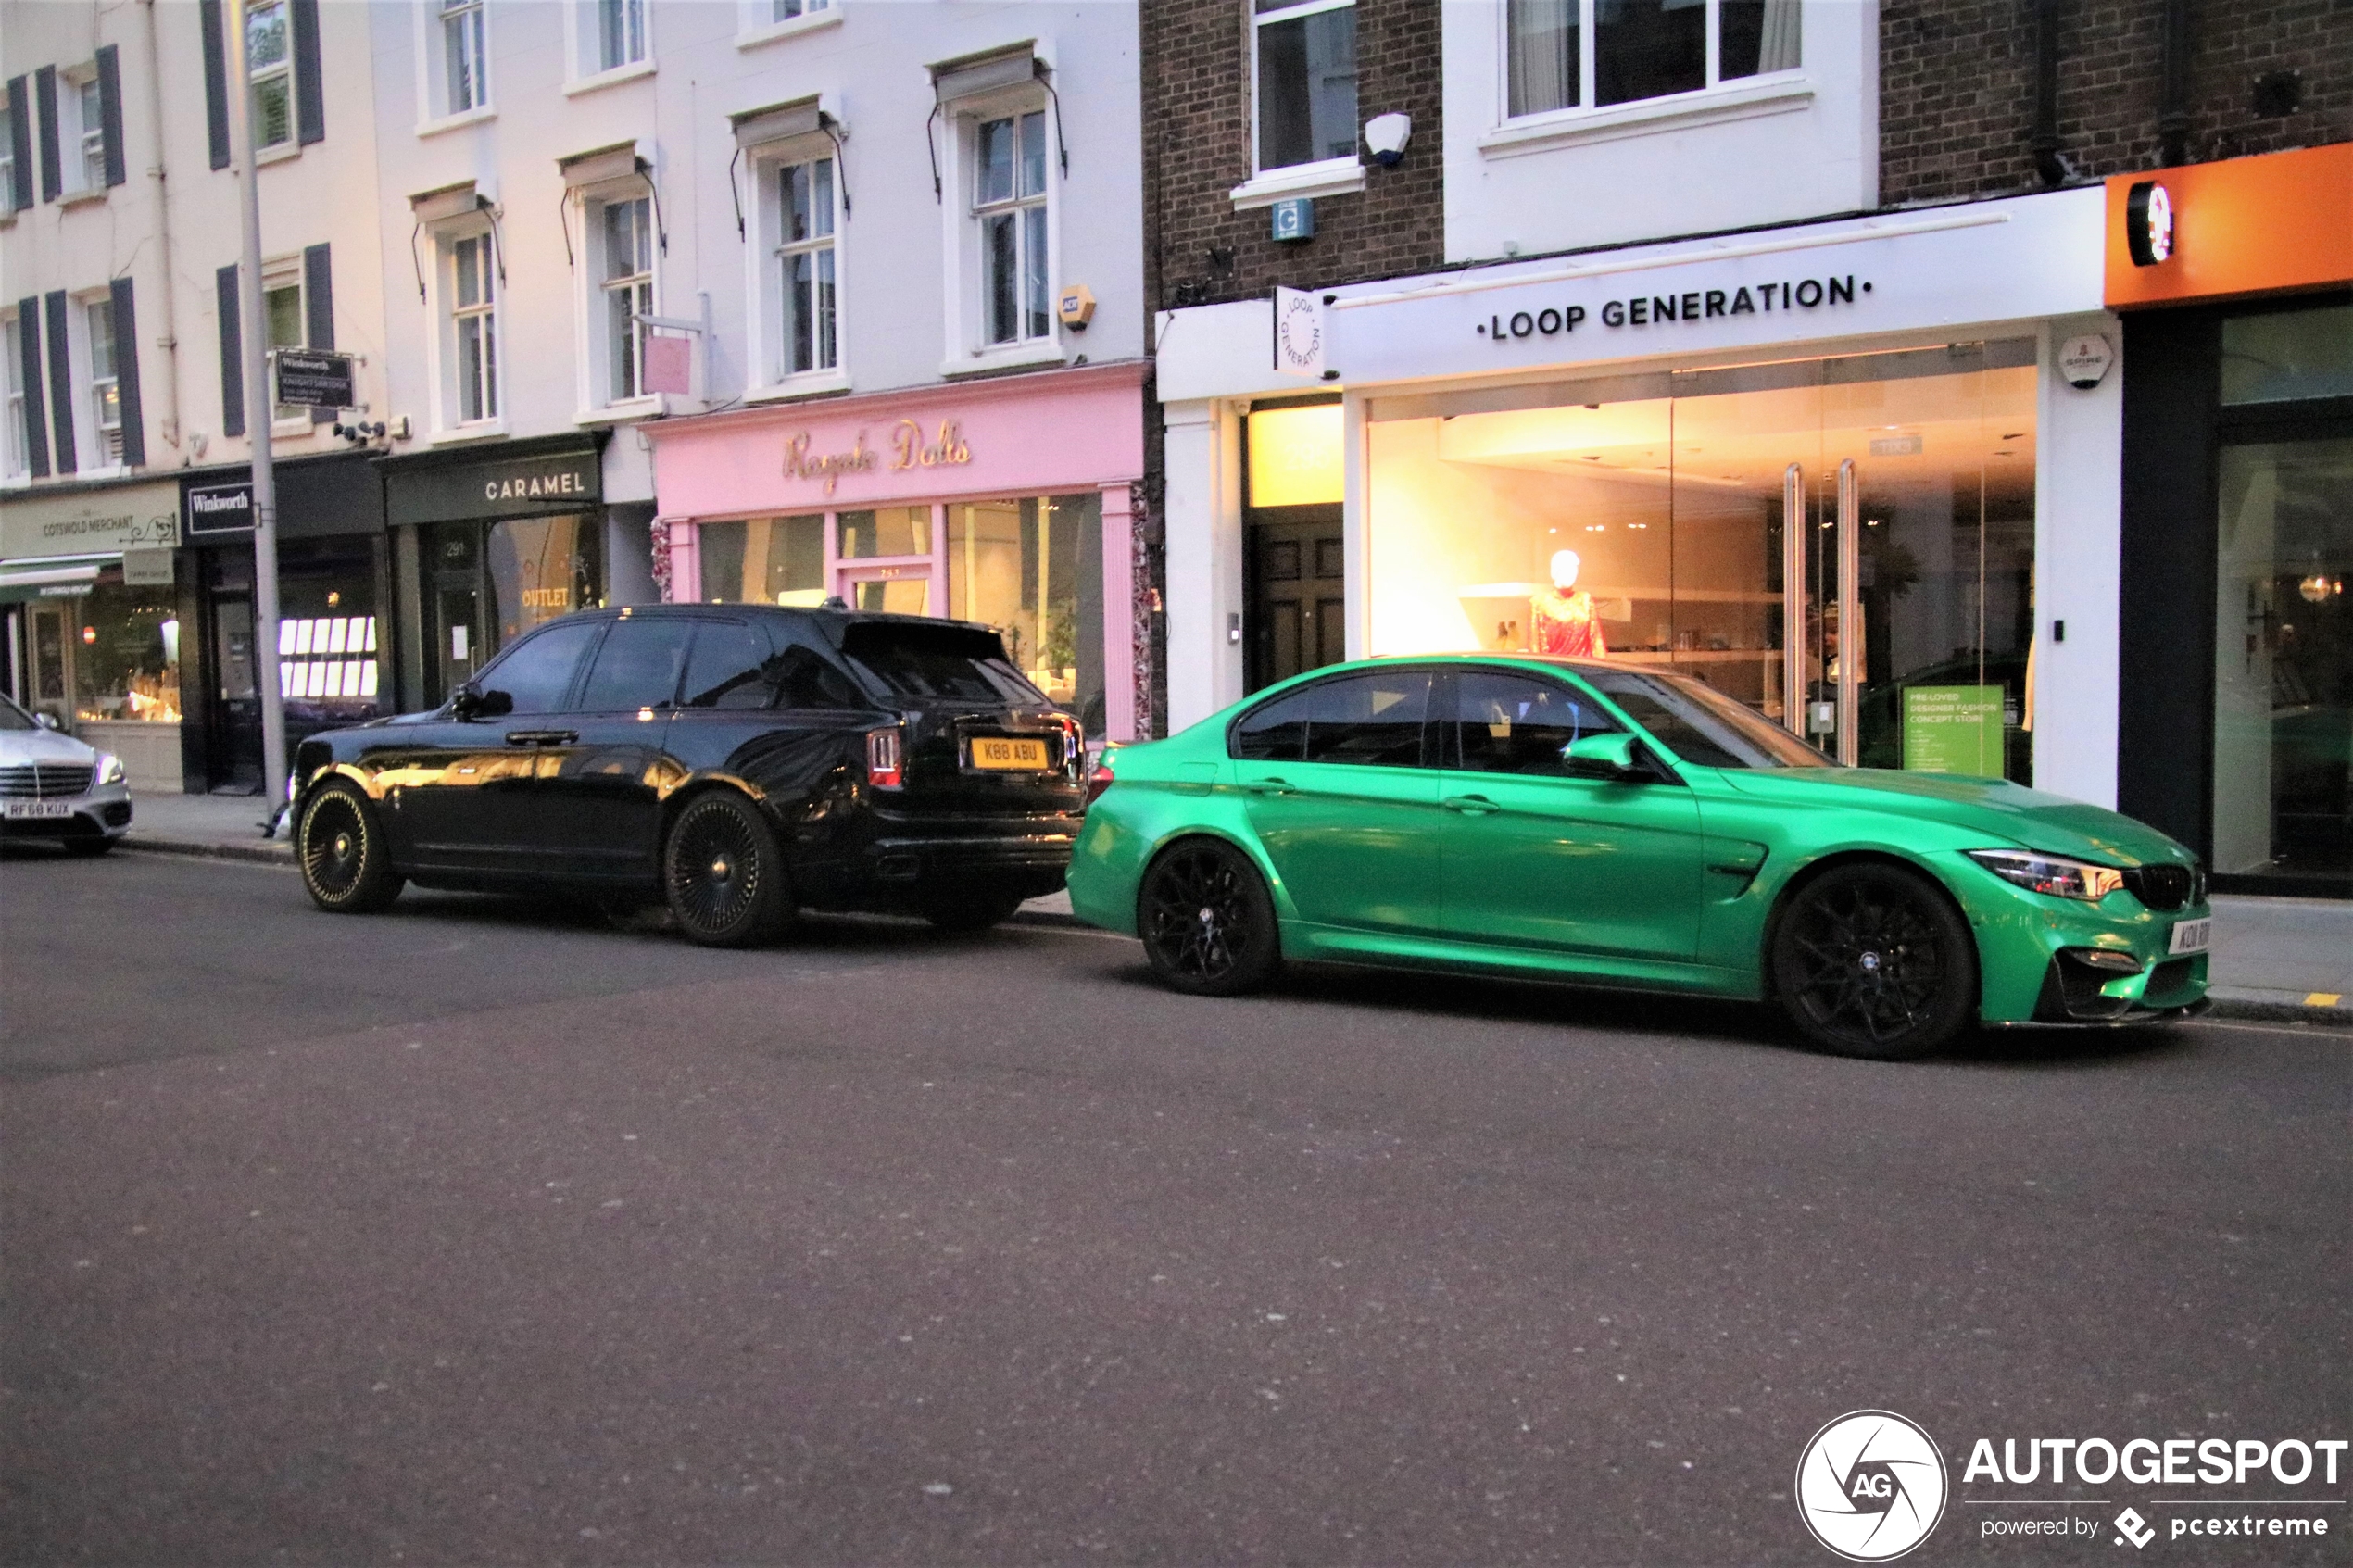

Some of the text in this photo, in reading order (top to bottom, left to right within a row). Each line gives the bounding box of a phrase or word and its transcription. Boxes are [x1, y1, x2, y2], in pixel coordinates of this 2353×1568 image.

[1289, 297, 1314, 313] LOOP
[1281, 321, 1320, 367] GENERATION
[888, 419, 971, 470] Dolls
[1284, 441, 1331, 470] 295
[485, 472, 585, 500] CARAMEL
[193, 491, 248, 512] Winkworth
[44, 515, 133, 537] COTSWOLD MERCHANT
[522, 588, 568, 607] OUTLET
[1910, 704, 1954, 712] DESIGNER
[1910, 714, 1983, 723] CONCEPT STORE
[984, 743, 1037, 760] K88 ABU
[10, 804, 69, 815] RF68 KUX
